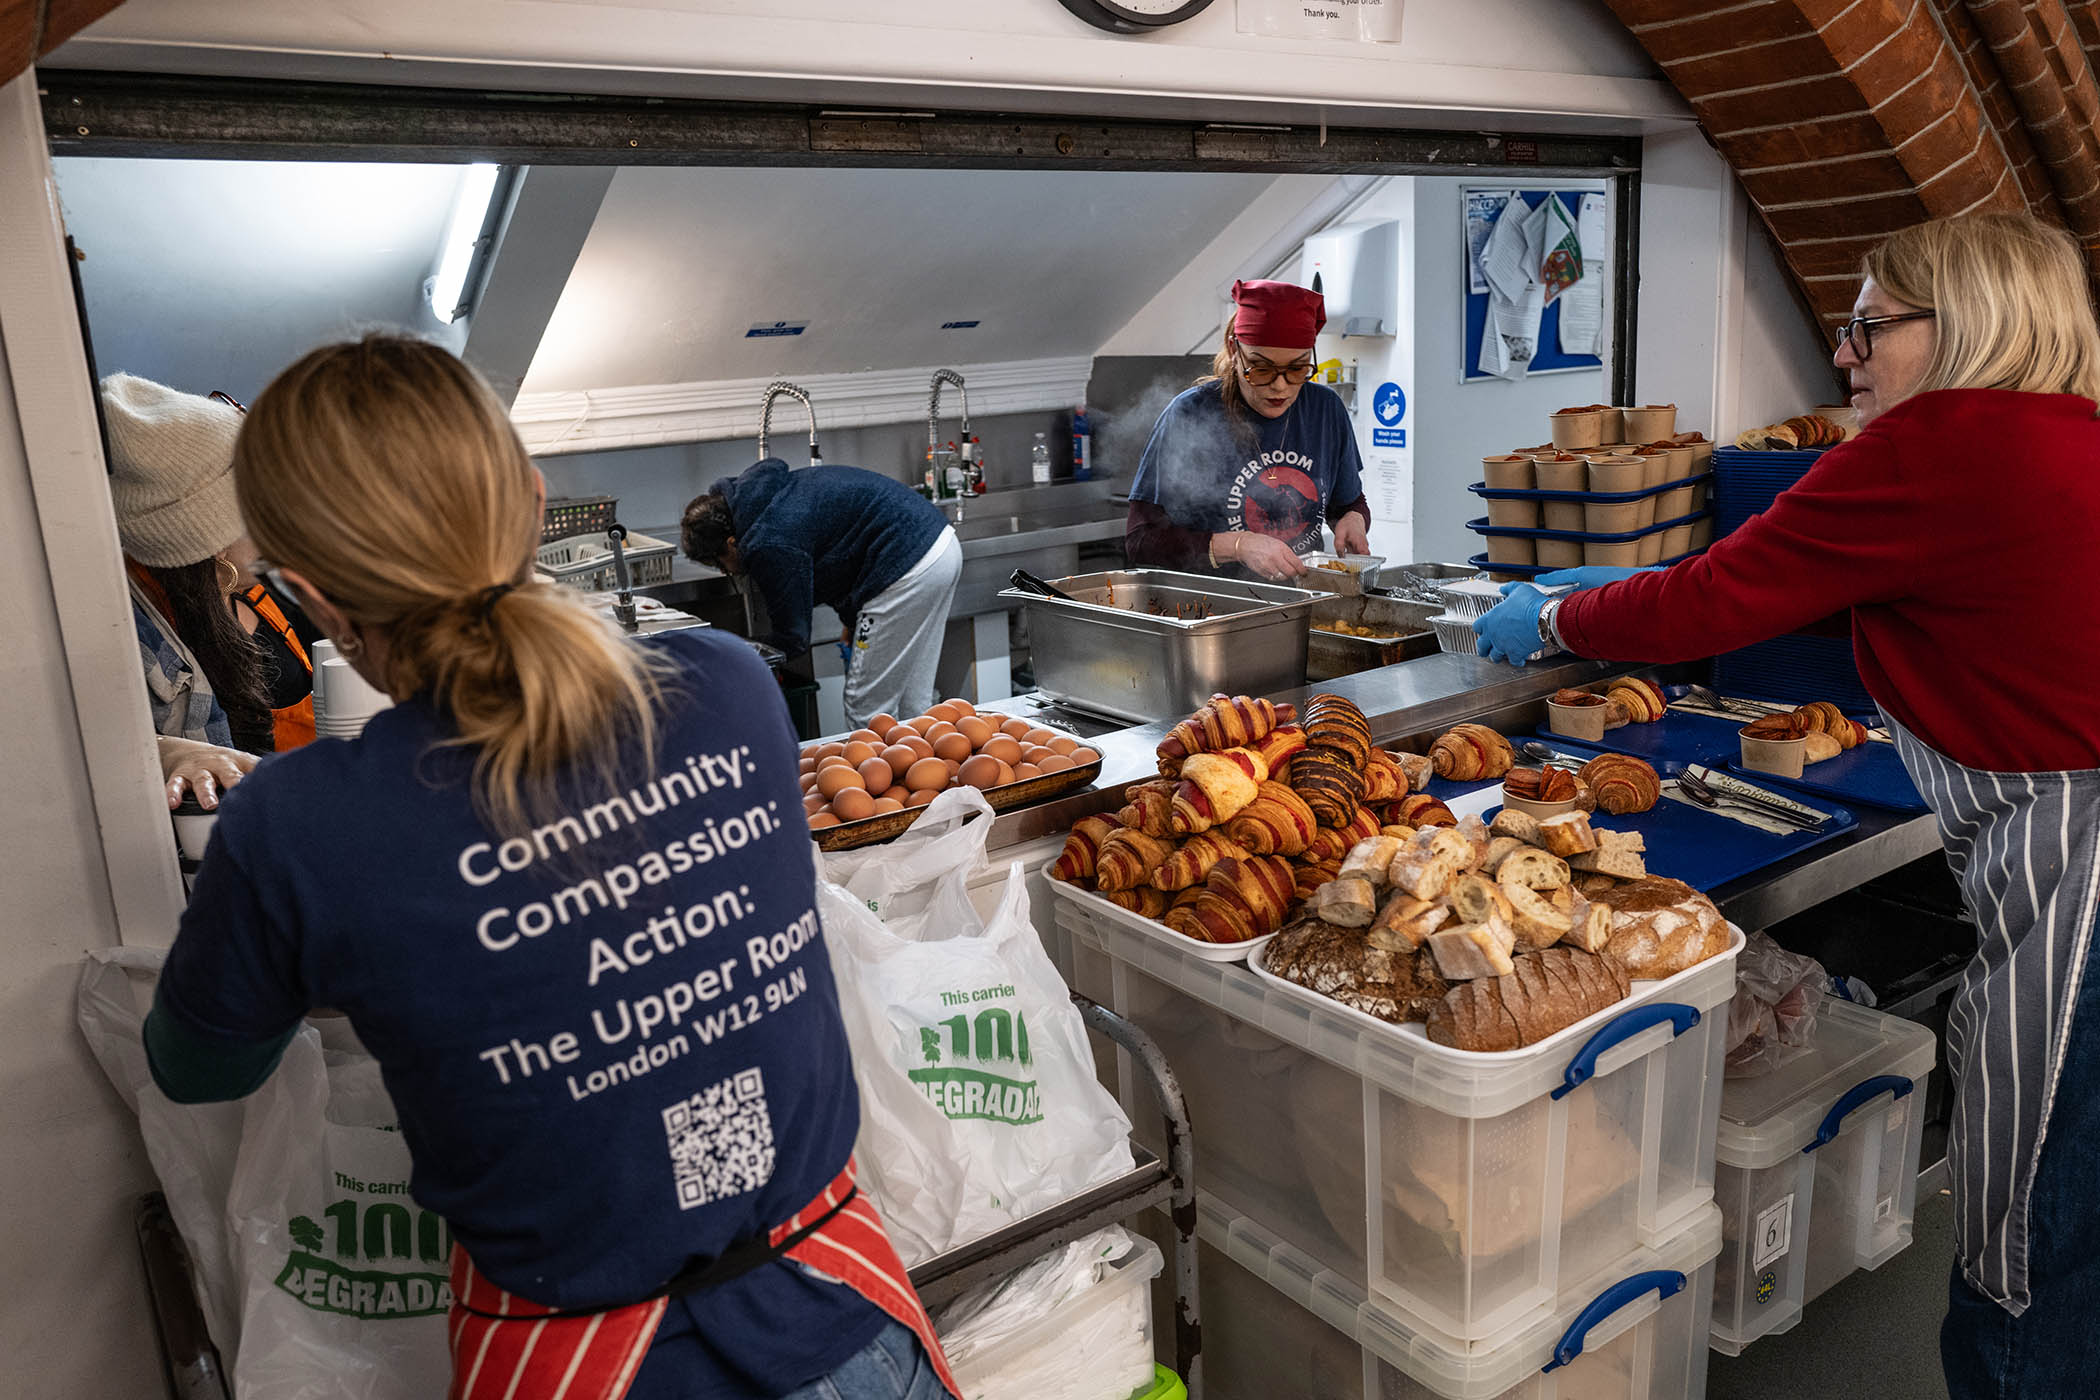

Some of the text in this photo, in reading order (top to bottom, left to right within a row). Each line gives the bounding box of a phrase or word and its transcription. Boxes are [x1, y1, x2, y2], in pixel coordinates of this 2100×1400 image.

[1304, 8, 1340, 19] Thank you.
[1468, 198, 1496, 211] HACCP
[1227, 449, 1314, 532] HE UPPER ROOM
[457, 743, 757, 887] Community:
[475, 799, 782, 953] Compassion:
[866, 899, 879, 912] is
[586, 883, 756, 987] Action:
[479, 906, 818, 1086] The Upper Room
[939, 989, 971, 1007] This
[566, 965, 808, 1102] London W12 9LN
[335, 1171, 412, 1196] This carri
[1766, 1217, 1778, 1248] 6
